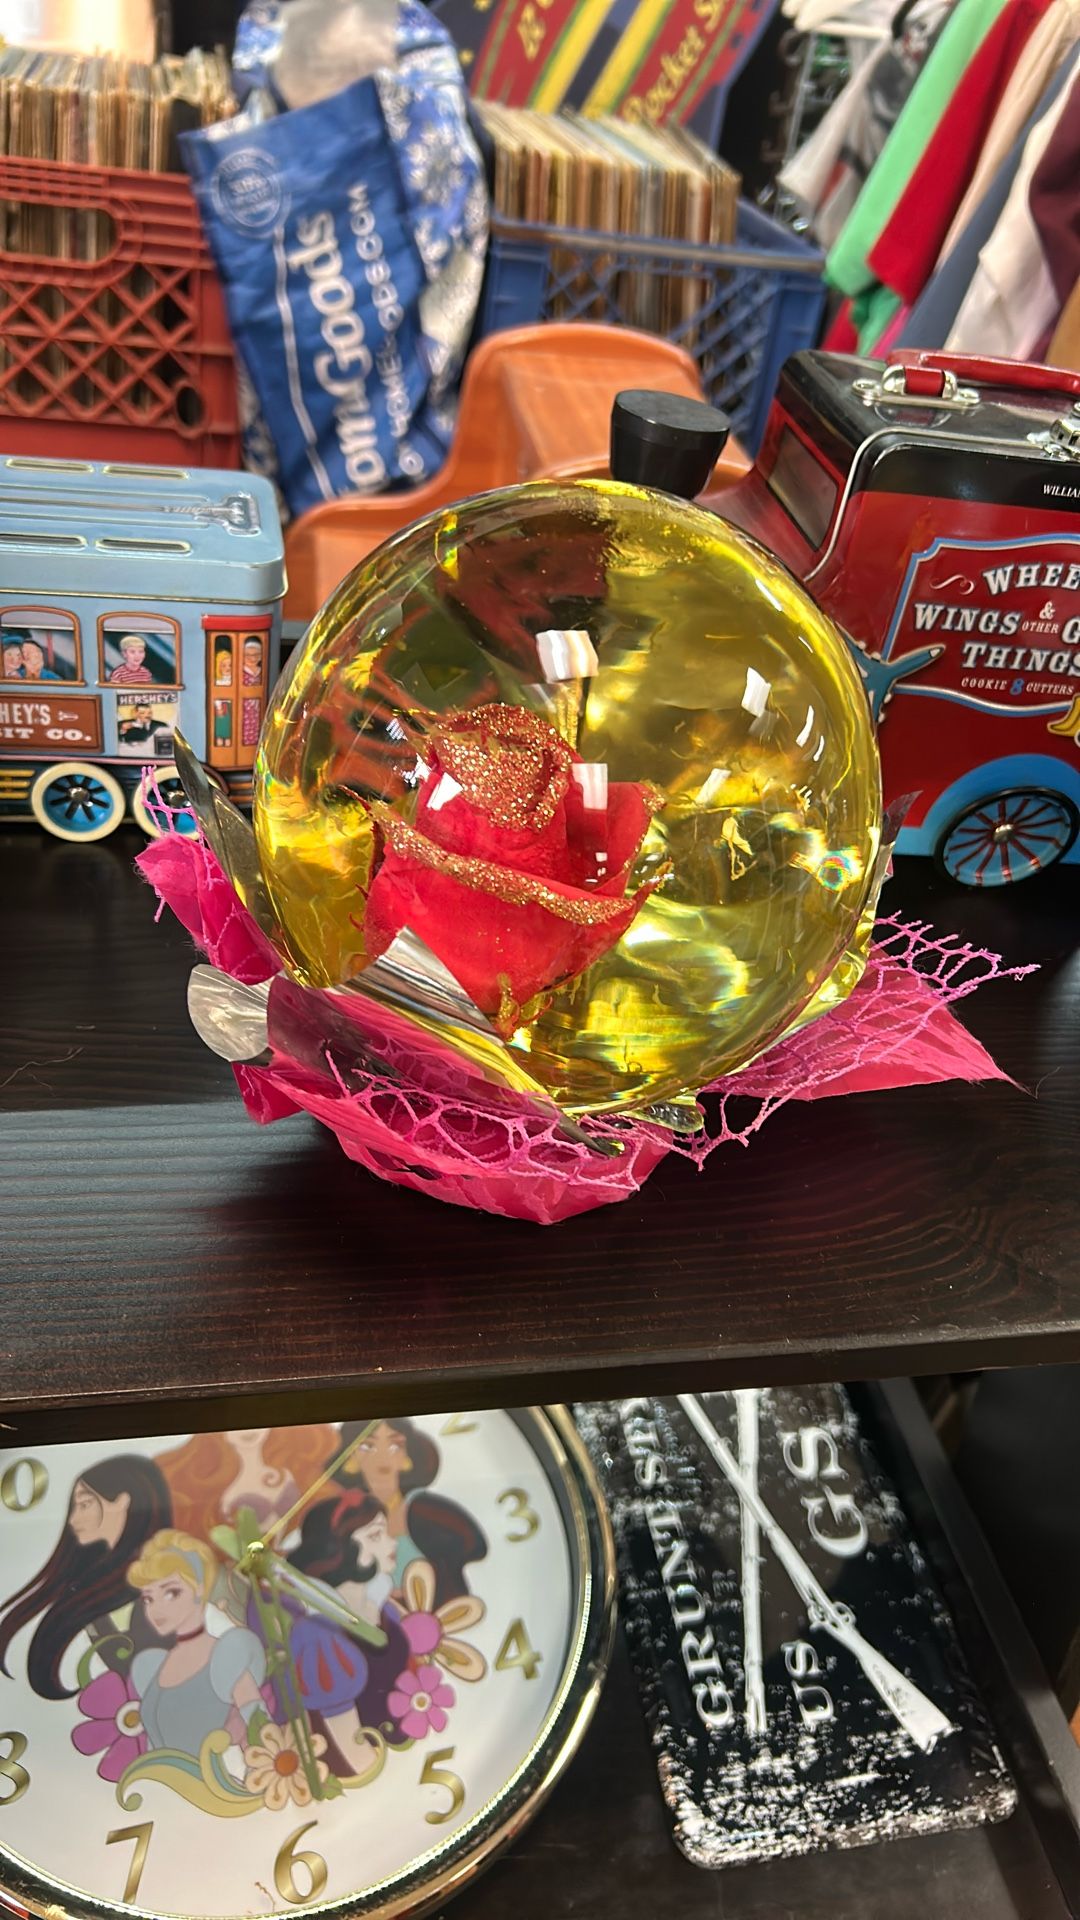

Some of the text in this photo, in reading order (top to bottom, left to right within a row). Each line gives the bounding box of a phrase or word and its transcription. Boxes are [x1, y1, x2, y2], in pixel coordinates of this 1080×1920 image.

[914, 602, 1021, 636] WINGS
[1021, 620, 1060, 635] OTHER
[1039, 600, 1056, 620] &
[961, 640, 1080, 677] THINGS
[961, 676, 1008, 690] COOKIE
[1025, 682, 1075, 696] CUTTERS
[0, 727, 92, 742] IT CO.
[497, 1486, 541, 1543] 3
[645, 1498, 735, 1729] GRUNT
[494, 1618, 542, 1680] 4
[418, 1746, 466, 1825] 5
[105, 1820, 154, 1904] 7
[273, 1820, 329, 1906] 6
